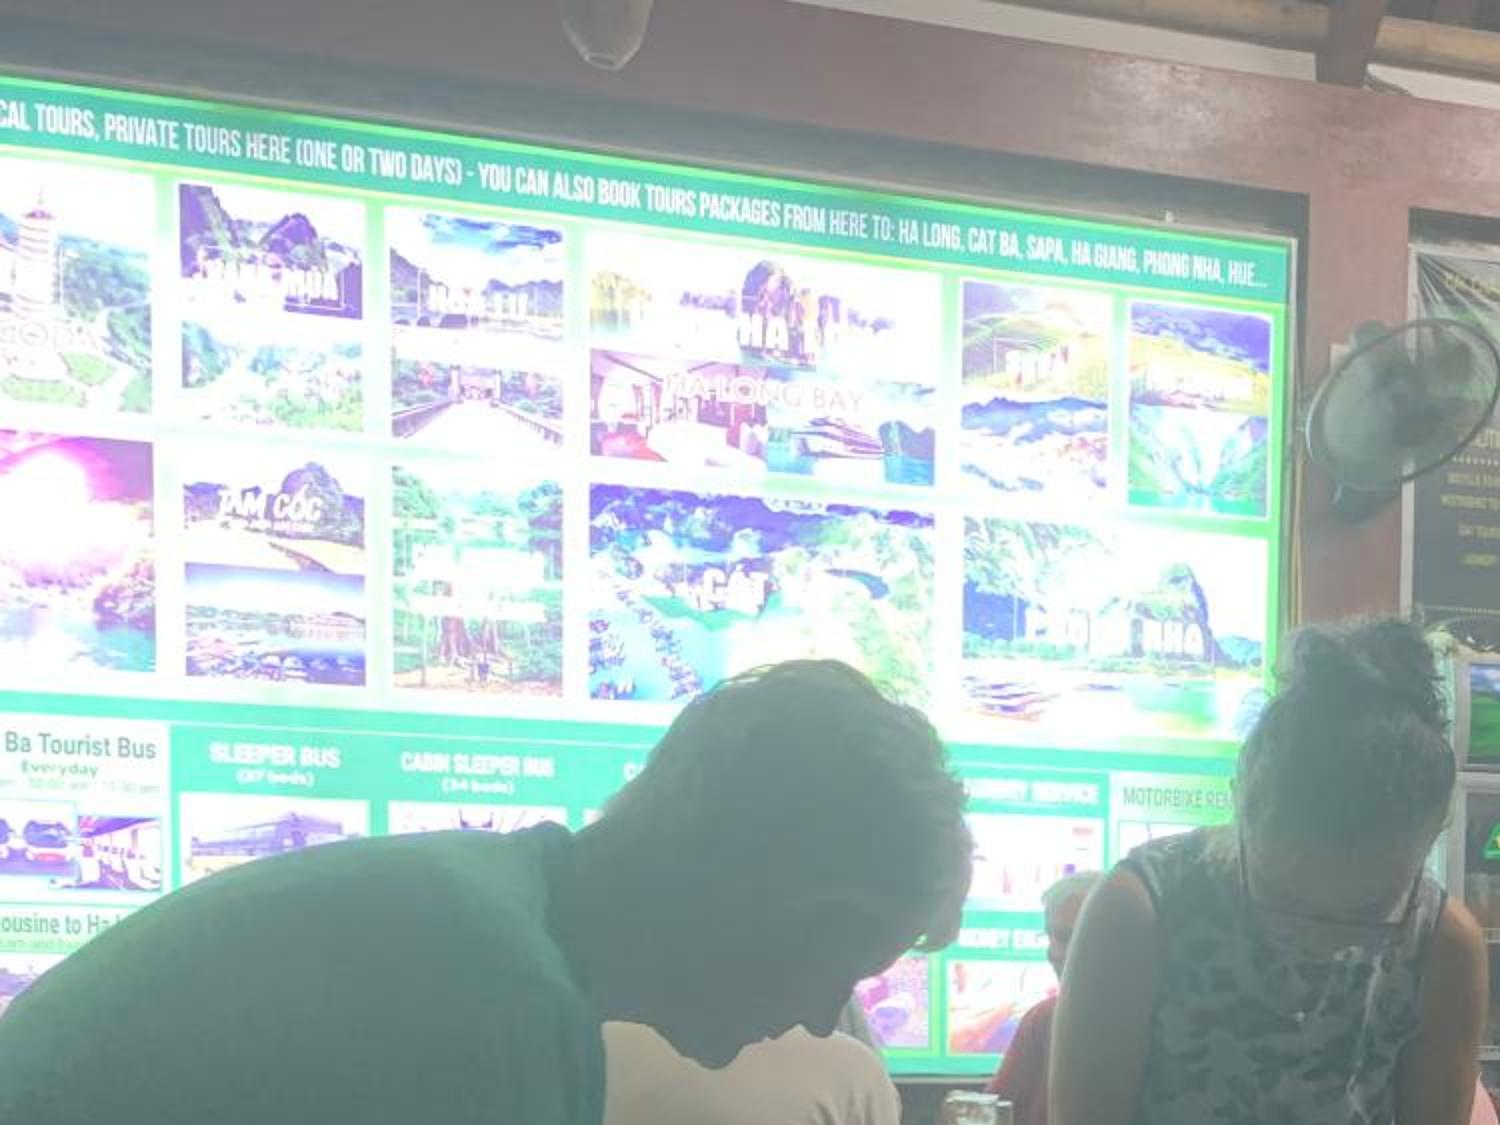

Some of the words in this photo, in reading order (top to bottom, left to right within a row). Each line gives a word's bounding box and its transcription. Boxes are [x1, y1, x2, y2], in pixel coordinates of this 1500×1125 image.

[35, 103, 100, 143] TOURS,
[104, 112, 180, 150] PRIVATE
[183, 122, 241, 157] TOURS
[246, 131, 291, 164] HERE
[296, 137, 337, 170] (ONE
[341, 145, 365, 173] OR
[367, 147, 406, 178] TWO
[411, 152, 462, 185] DAYS)
[477, 161, 512, 193] YOU
[515, 166, 549, 197] CAN
[553, 172, 593, 203] ALSO
[598, 178, 641, 210] BOOK
[644, 183, 697, 217] TOURS
[699, 190, 781, 228] PACKAGES
[783, 202, 826, 235] FROM
[829, 208, 867, 239] HERE
[871, 214, 895, 241] TO:
[898, 217, 919, 246] HA
[967, 225, 996, 256] CAT
[1071, 240, 1091, 266] HA
[1143, 249, 1190, 280] PHONG
[4, 729, 32, 754] Ba
[37, 731, 112, 758] Tourist
[116, 736, 158, 760] Bus
[208, 740, 296, 767] SLEEPER
[298, 744, 342, 770] BUS
[452, 753, 521, 776] SLEEPER
[1121, 785, 1201, 810] MOTORBIKE
[65, 913, 82, 935] to
